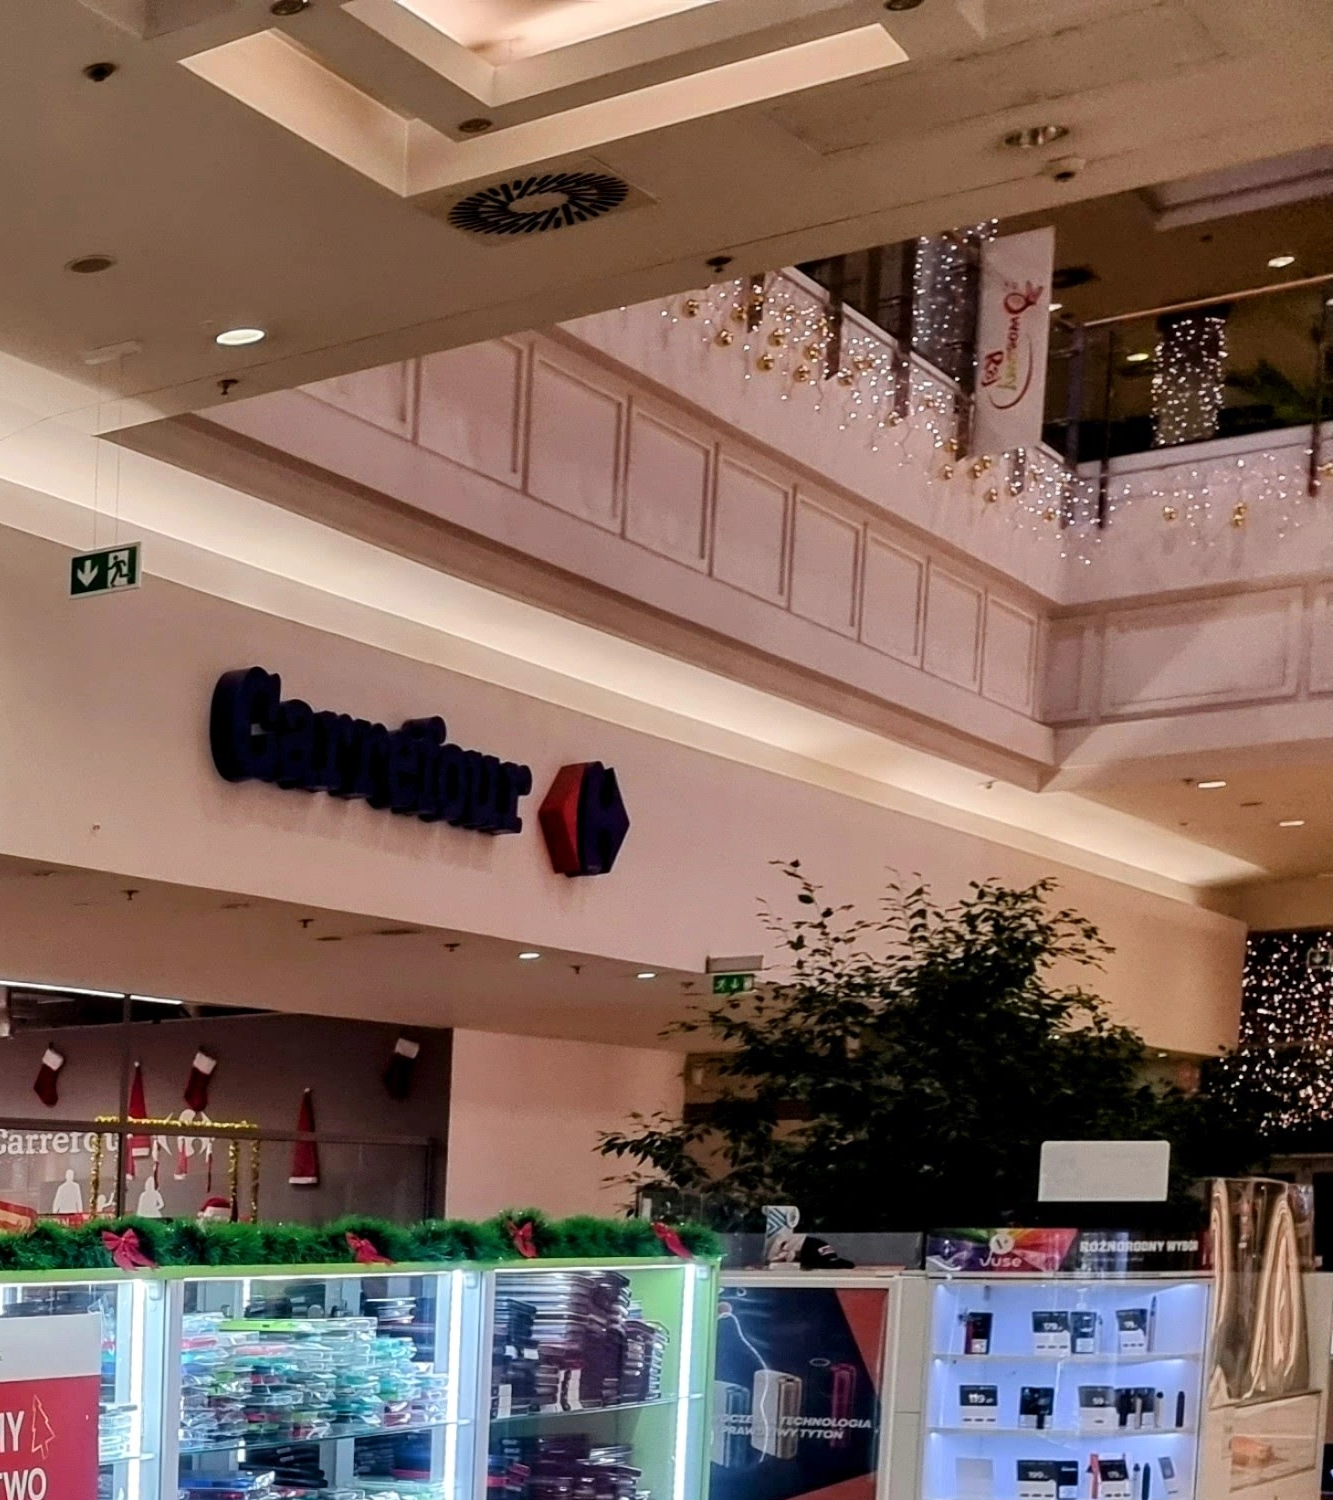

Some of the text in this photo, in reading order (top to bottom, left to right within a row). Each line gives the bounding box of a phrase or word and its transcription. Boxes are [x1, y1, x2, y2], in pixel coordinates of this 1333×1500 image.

[210, 667, 533, 834] Carrefour
[781, 1416, 872, 1430] TECHNOLOGIA
[800, 1428, 844, 1440] TYTOŃ
